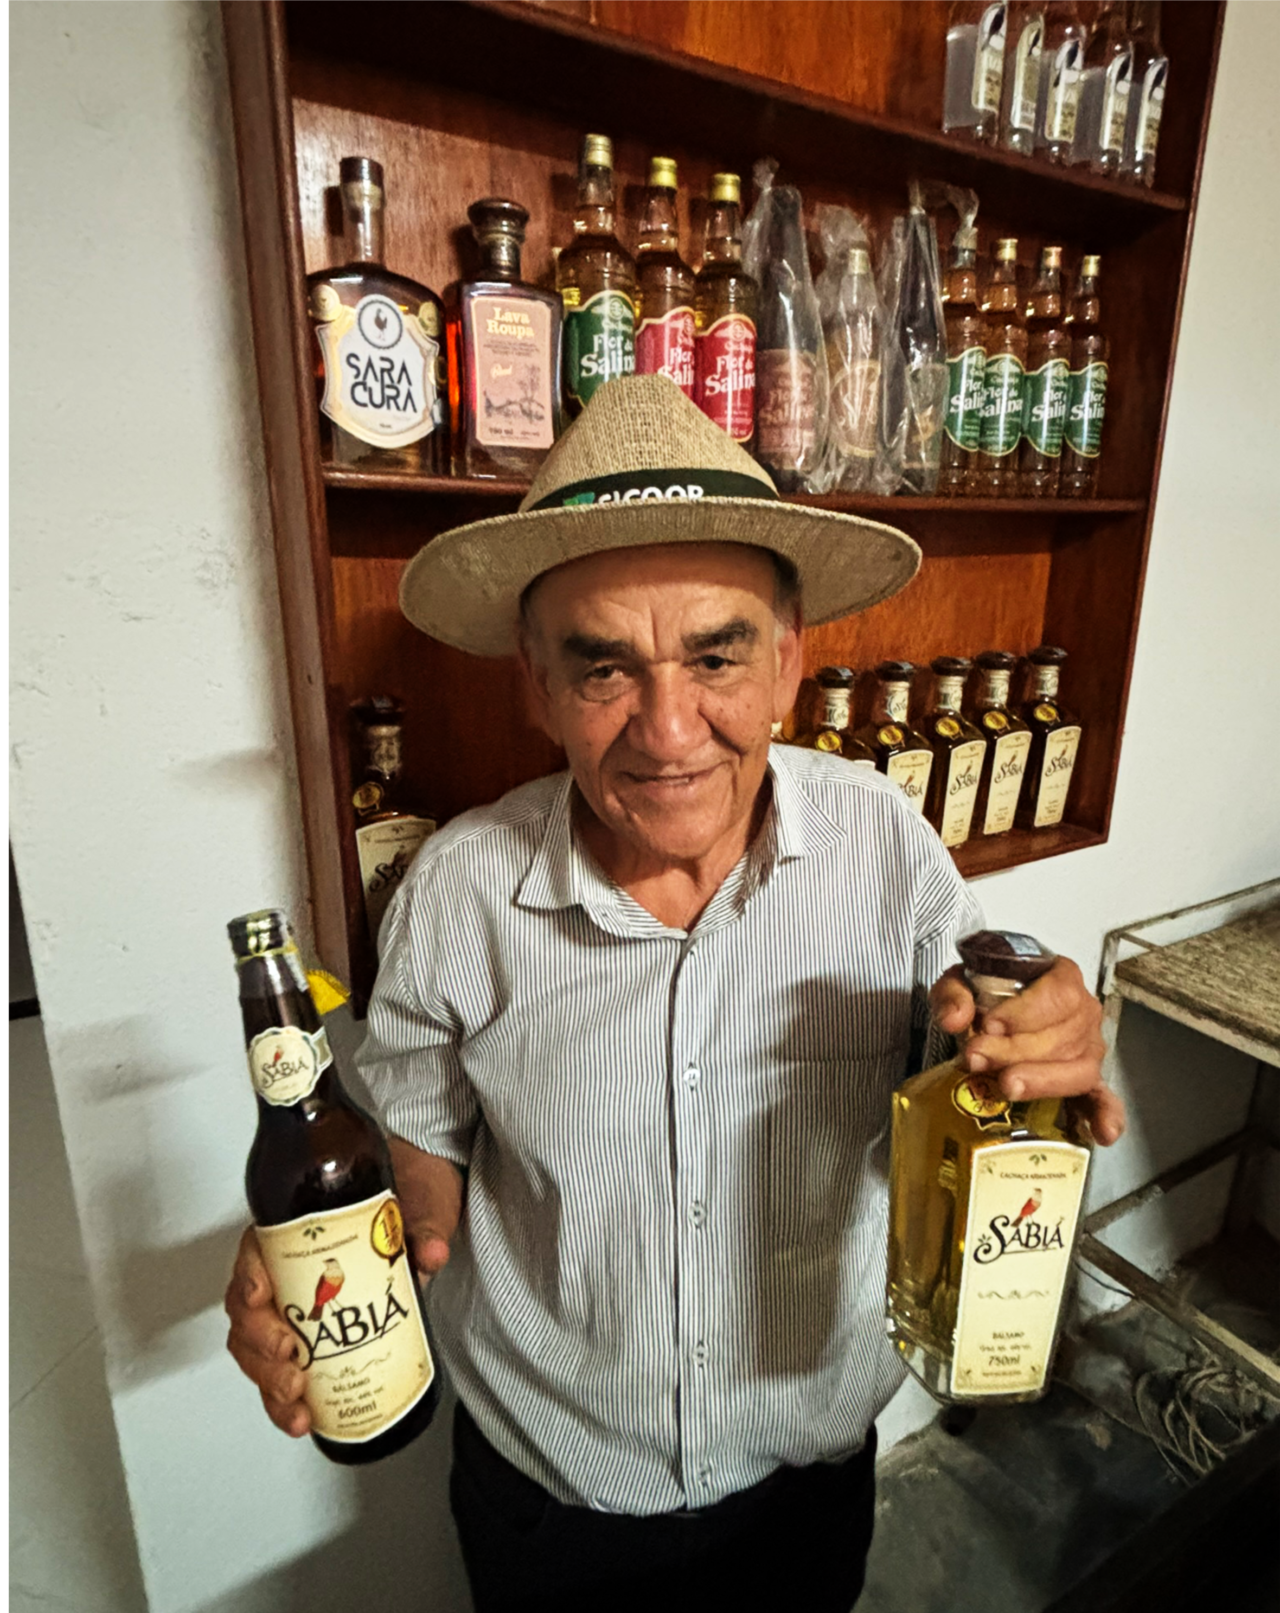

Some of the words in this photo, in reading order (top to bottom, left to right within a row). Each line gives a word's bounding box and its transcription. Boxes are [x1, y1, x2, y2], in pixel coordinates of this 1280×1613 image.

[486, 319, 535, 340] Roupa
[493, 307, 530, 325] Lava
[346, 352, 412, 386] SARA
[350, 381, 417, 413] CURA
[973, 1214, 1065, 1264] SABIÁ
[284, 1279, 409, 1371] SABIÁ
[339, 1400, 377, 1419] 600ml
